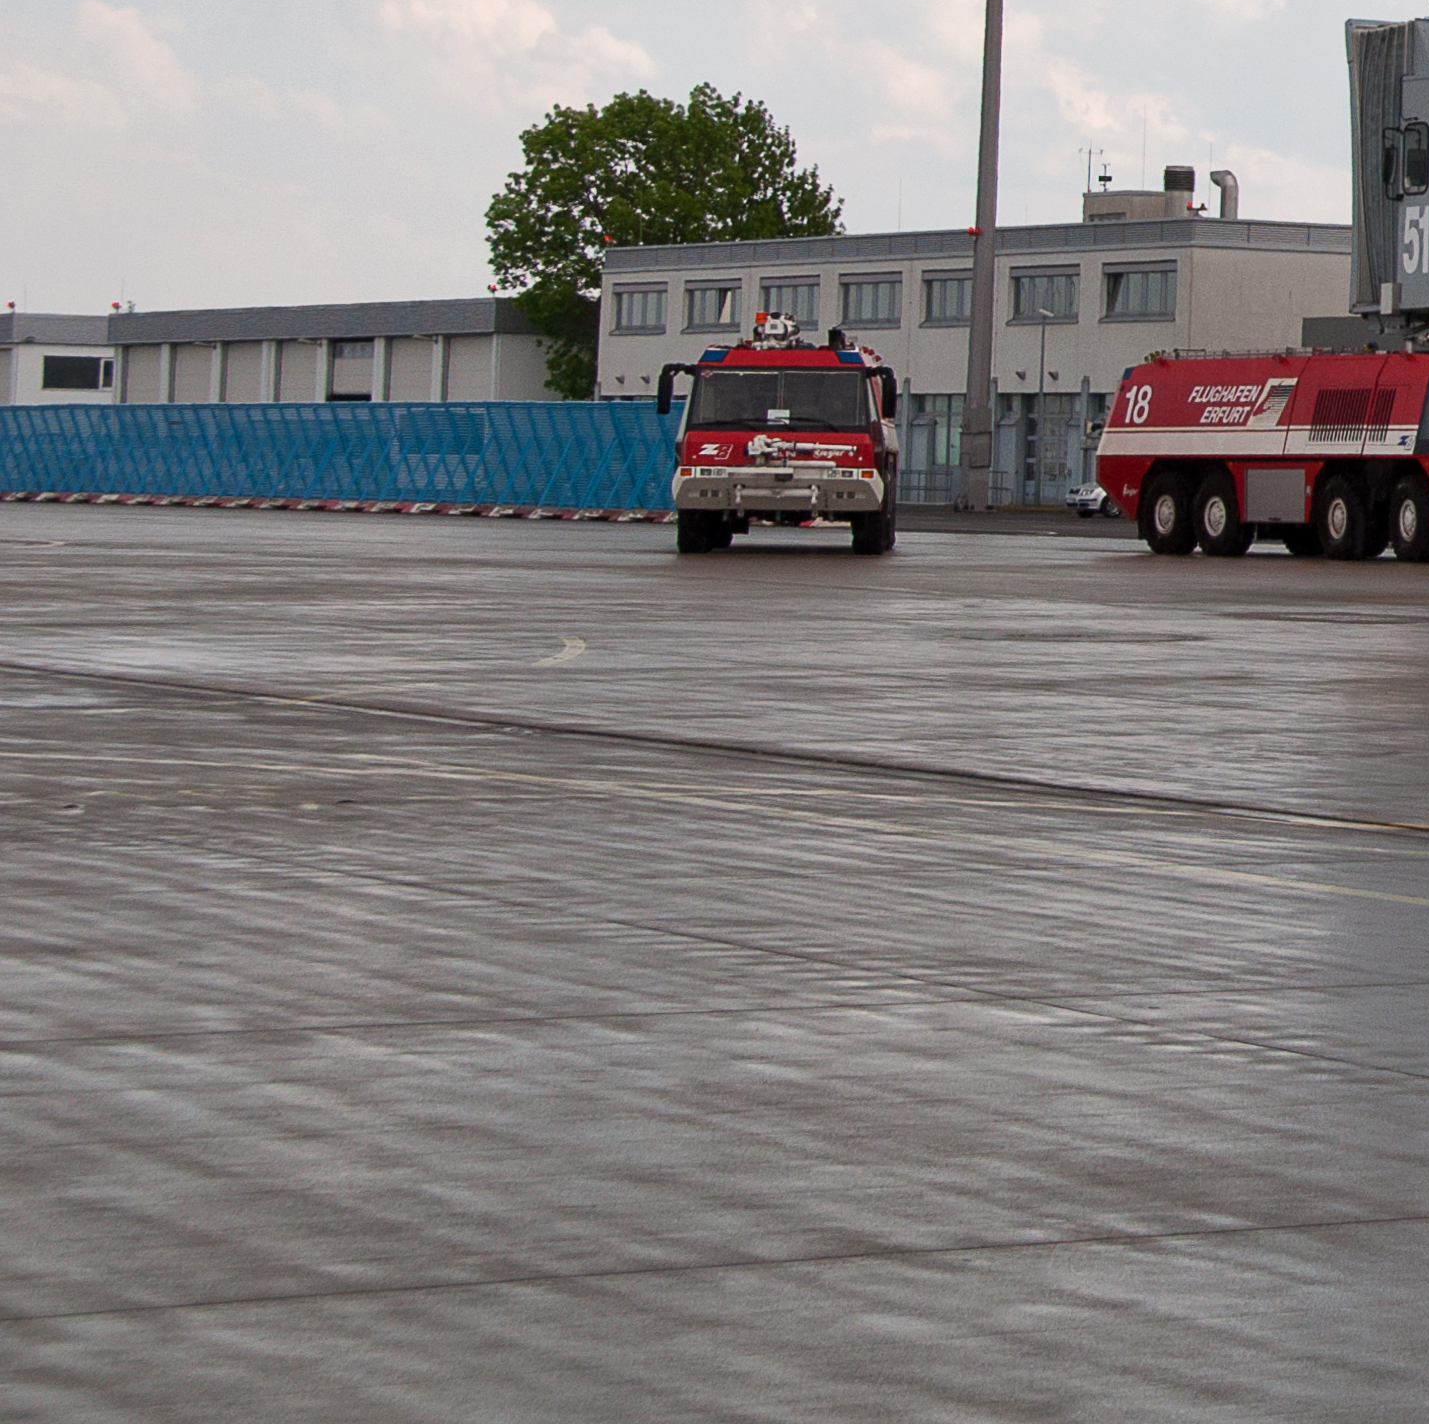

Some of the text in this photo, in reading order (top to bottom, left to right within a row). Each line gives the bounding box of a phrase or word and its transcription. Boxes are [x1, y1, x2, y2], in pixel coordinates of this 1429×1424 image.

[1403, 205, 1429, 275] 51
[1187, 385, 1262, 403] FLUGHAFEN
[1124, 384, 1152, 424] 18
[1199, 406, 1253, 423] ERFURT
[698, 443, 734, 460] Z8
